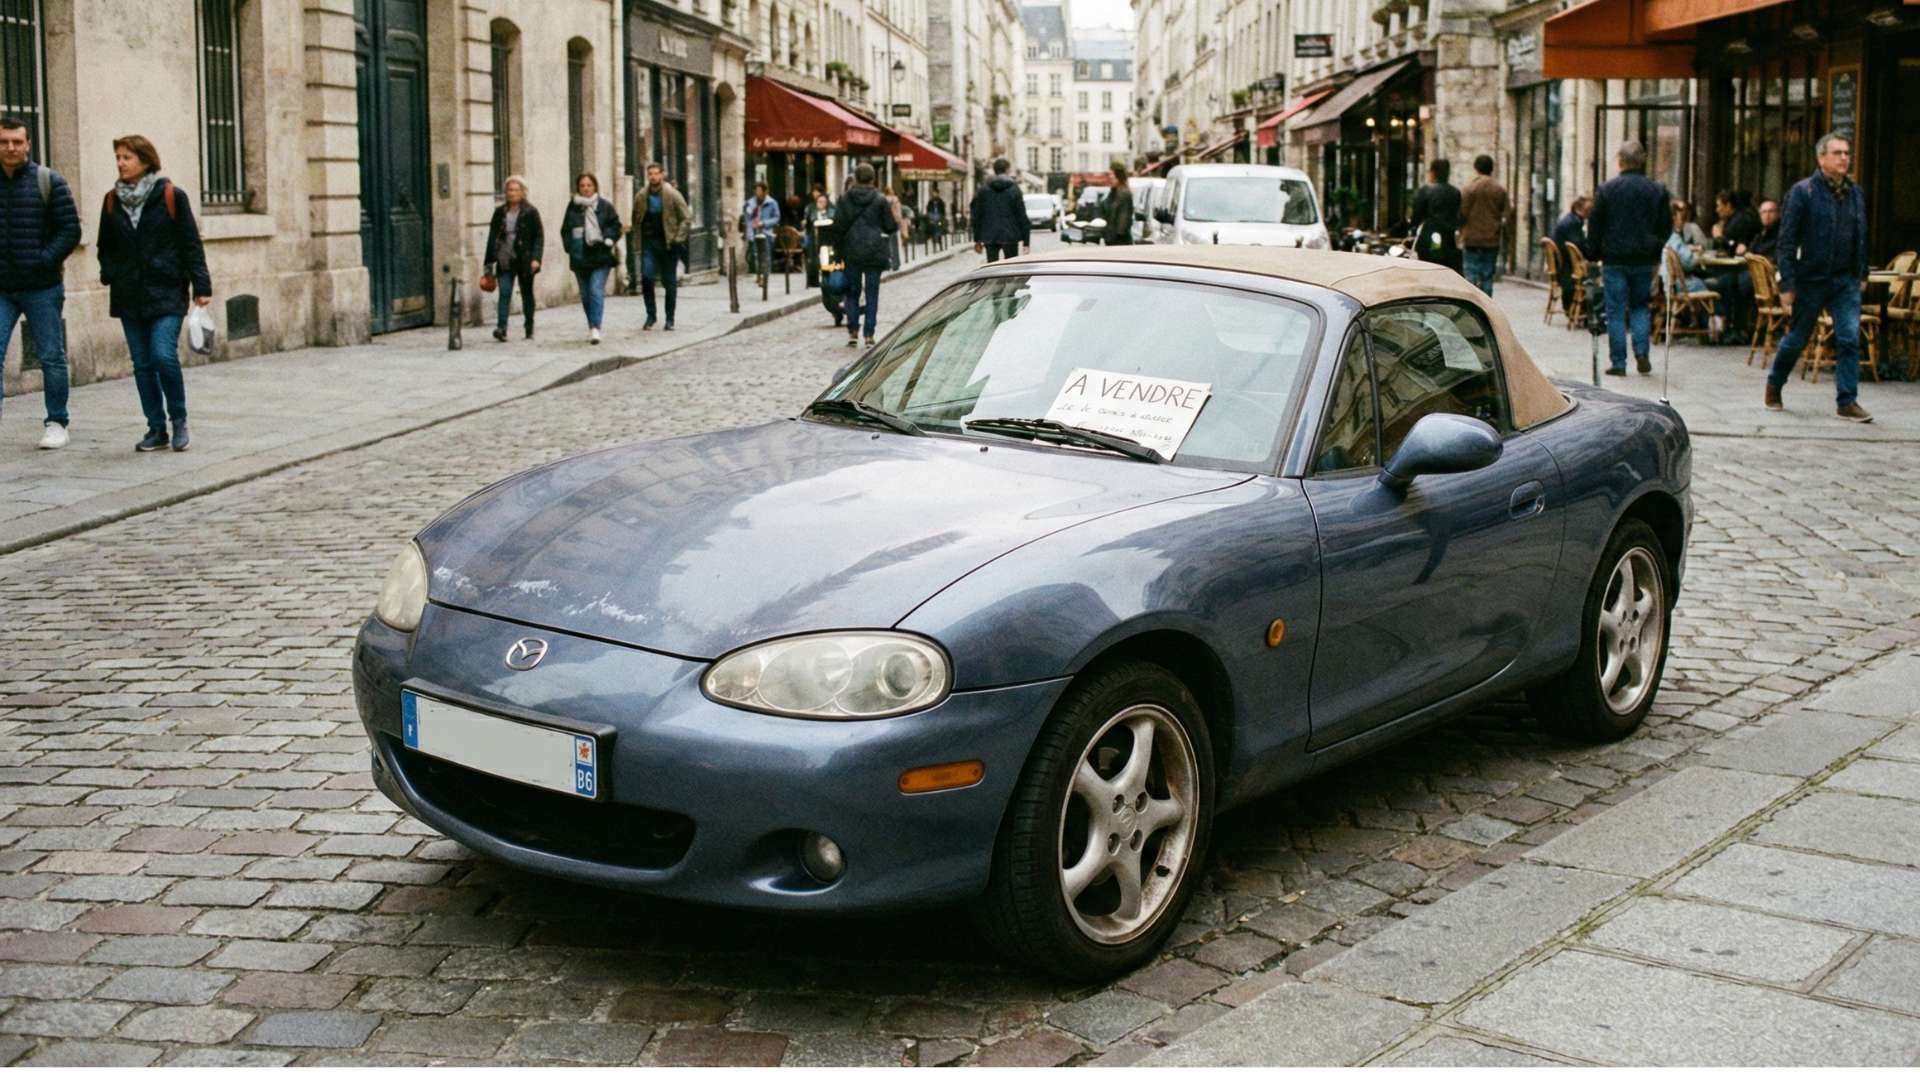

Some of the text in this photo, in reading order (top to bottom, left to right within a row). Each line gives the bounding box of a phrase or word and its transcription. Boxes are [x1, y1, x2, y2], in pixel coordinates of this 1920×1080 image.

[1064, 373, 1202, 410] A VENDRE
[577, 768, 593, 792] B6
